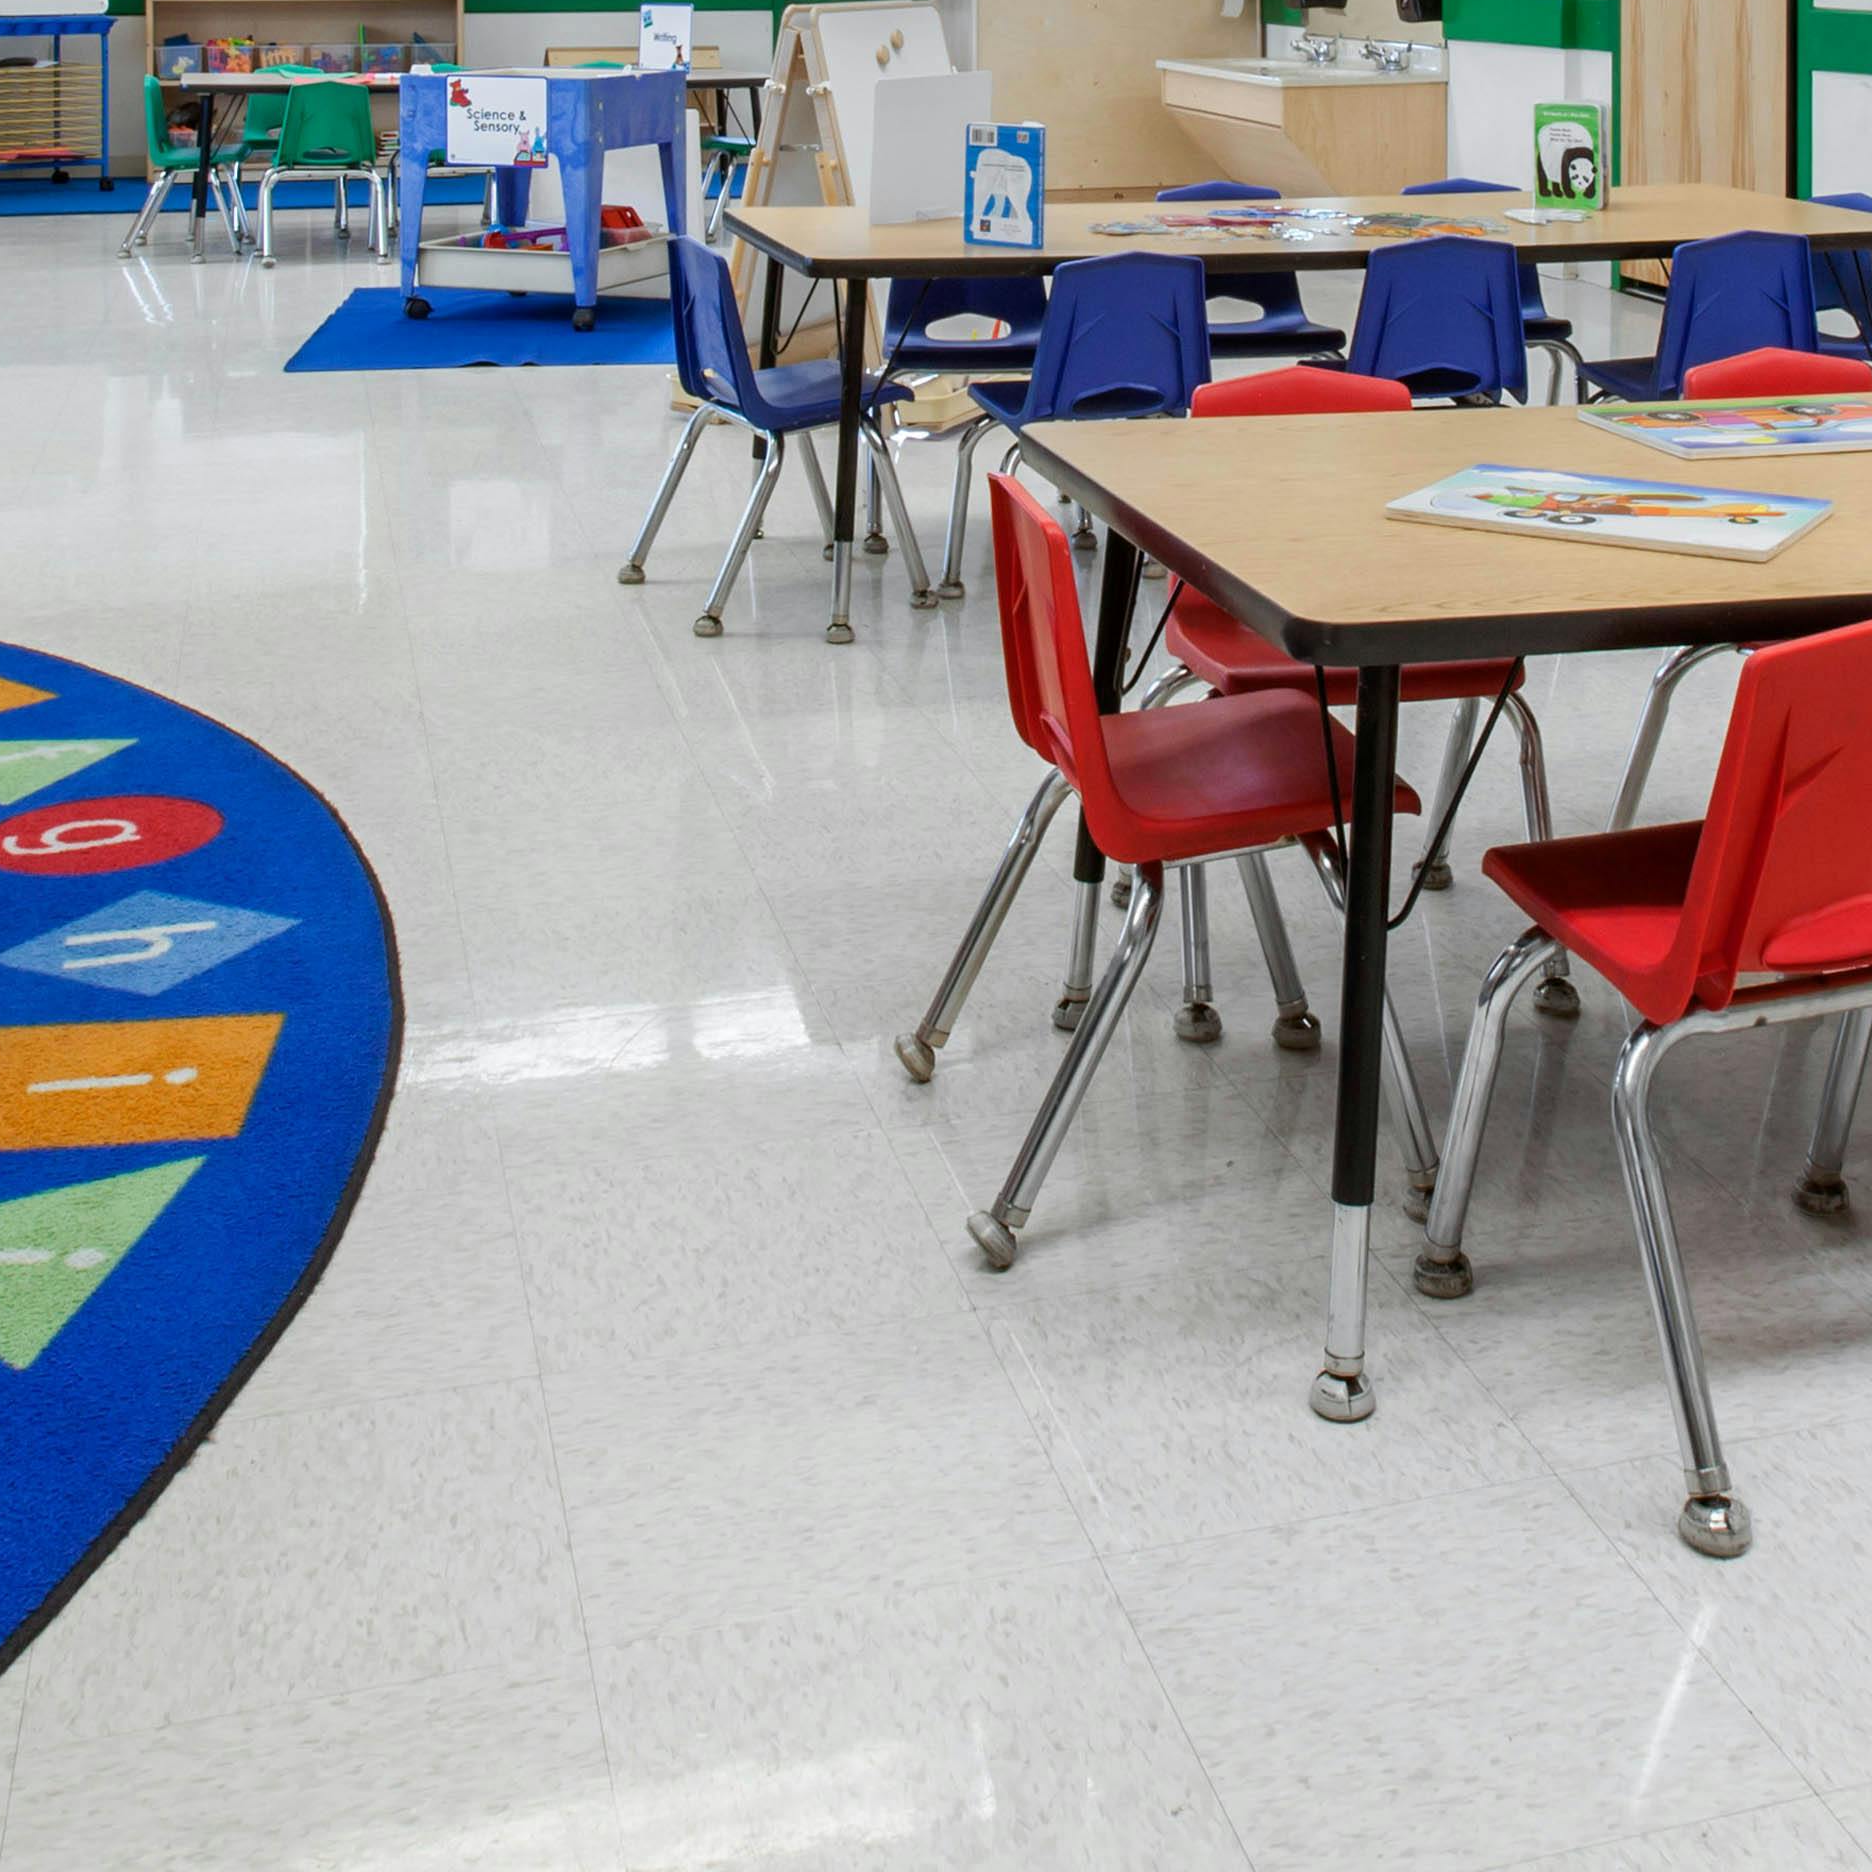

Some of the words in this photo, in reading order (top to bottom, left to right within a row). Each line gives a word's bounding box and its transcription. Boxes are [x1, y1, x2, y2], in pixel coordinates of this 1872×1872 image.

[467, 108, 516, 121] Science
[519, 110, 527, 121] &
[474, 120, 521, 135] Sensory
[1, 818, 141, 856] g
[61, 920, 217, 971] h
[28, 1066, 198, 1093] i
